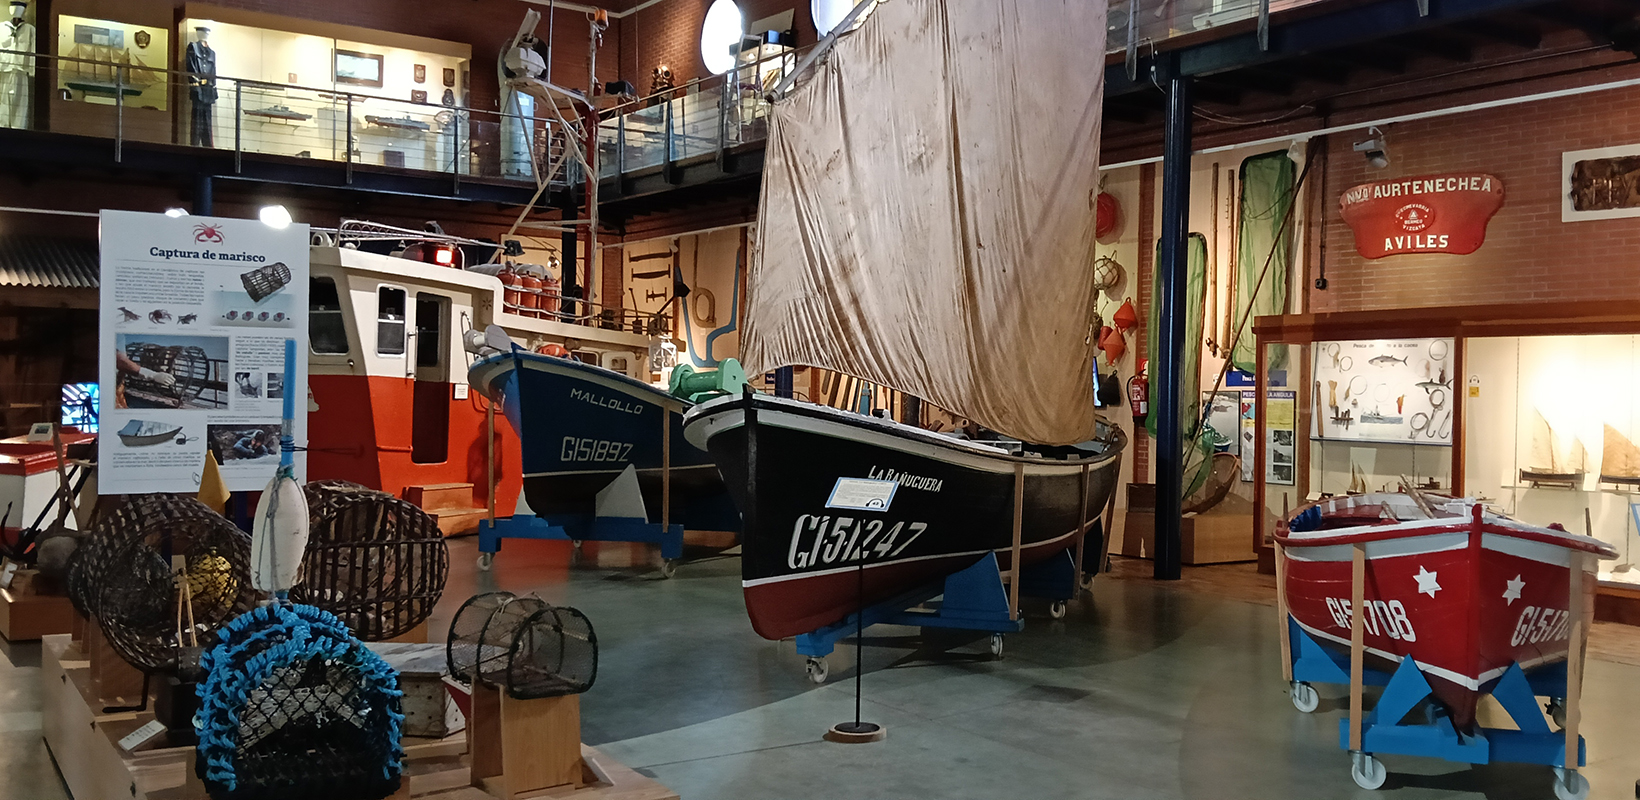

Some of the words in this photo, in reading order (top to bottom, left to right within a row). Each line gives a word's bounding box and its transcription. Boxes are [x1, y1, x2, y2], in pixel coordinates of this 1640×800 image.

[1374, 177, 1491, 199] AURTENECHEA
[1384, 234, 1450, 252] AVILES
[149, 246, 200, 260] Captura
[202, 249, 216, 259] de
[218, 251, 266, 263] marisco
[570, 387, 643, 415] MALLOLLO
[868, 465, 884, 480] LA
